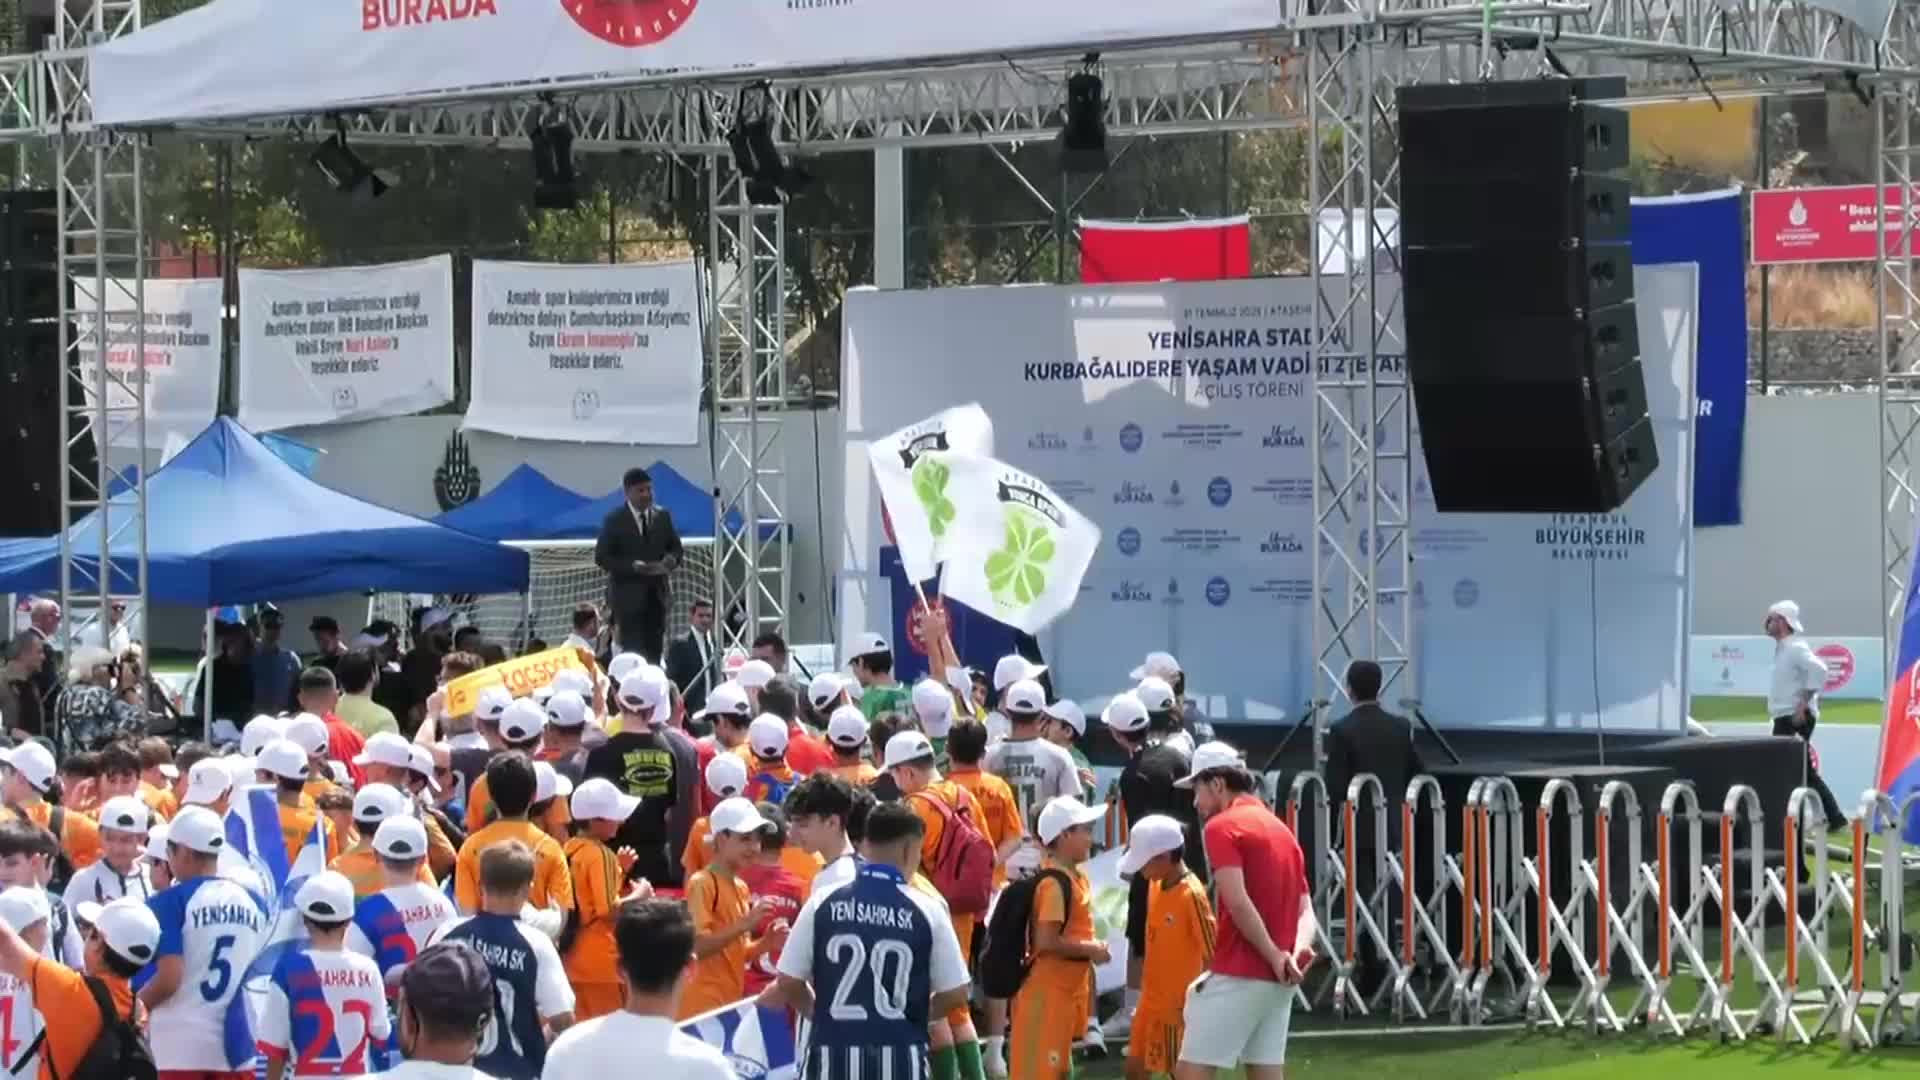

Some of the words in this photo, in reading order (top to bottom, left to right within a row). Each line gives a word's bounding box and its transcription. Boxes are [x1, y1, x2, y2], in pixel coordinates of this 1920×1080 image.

[1148, 325, 1261, 349] YENİSAHRA
[1024, 355, 1182, 382] KURBAĞALIDERE
[1186, 356, 1257, 380] YAŞAM
[1194, 383, 1244, 400] AÇILIŞ
[1247, 380, 1304, 398] TÖRENİ
[1535, 525, 1645, 546] BÜYÜKŞEHİR
[829, 896, 855, 923] YENİ
[856, 903, 896, 927] SAHRA
[897, 909, 914, 931] SK
[200, 934, 237, 1002] 5
[509, 948, 527, 972] SK
[358, 970, 371, 988] SK
[825, 933, 914, 1021] 20
[296, 999, 371, 1076] 22
